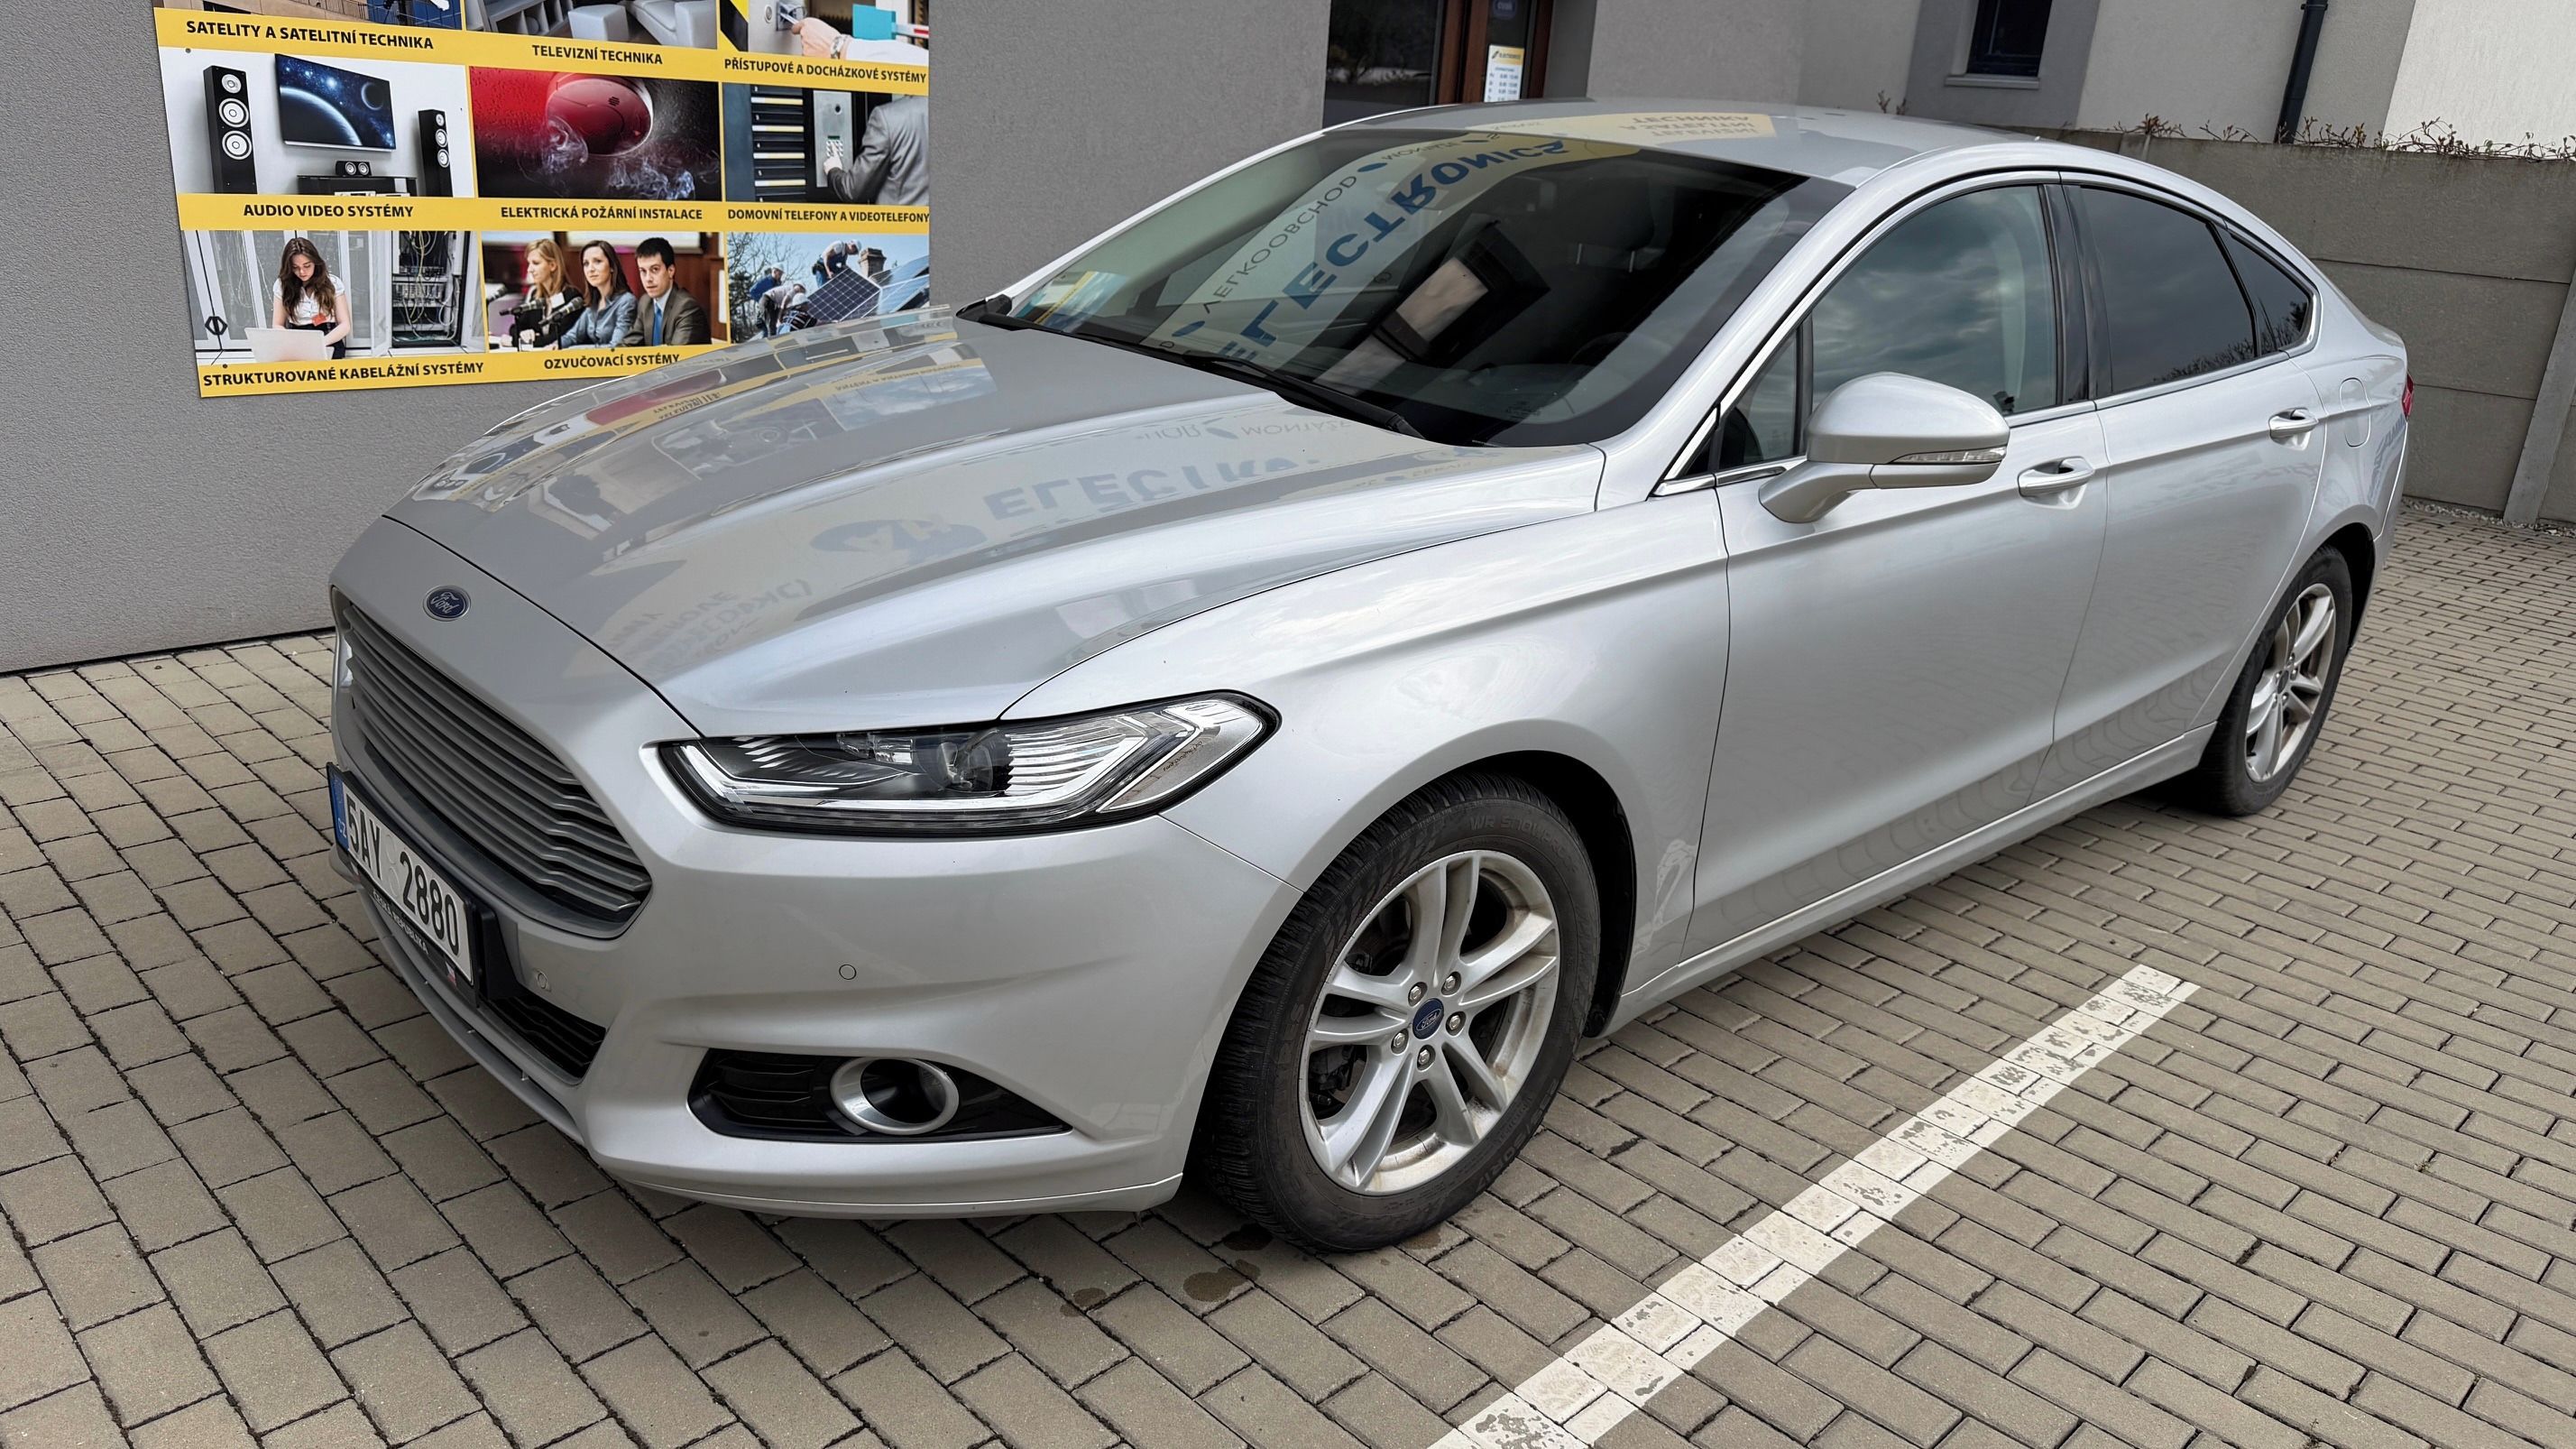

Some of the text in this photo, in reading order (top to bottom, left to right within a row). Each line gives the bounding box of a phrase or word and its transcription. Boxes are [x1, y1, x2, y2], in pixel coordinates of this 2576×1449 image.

[186, 20, 435, 50] SATELITY A SATELITNÍ TECHNIKA
[531, 44, 663, 66] TELEVIZNÍ TECHNIKA
[723, 56, 927, 85] PŘÍSTUPOVÉ A DOCHÁZKOVÉ SYSTÉMY
[244, 203, 414, 217] AUDIO VIDEO SYSTÉMY
[500, 205, 703, 220] ELEKTRICKÁ POŽÁRNÍ INSTALACE
[727, 207, 930, 224] DOMOVNÍ TELEFONY A VIDEOTELEFONY
[543, 351, 680, 371] OZVUČOVACÍ SYSTÉMY
[202, 360, 484, 388] STRUKTUROVANÉ KABELÁŽNÍ SYSTÉMY
[337, 817, 348, 839] CZ
[346, 794, 459, 956] 5AY 2880
